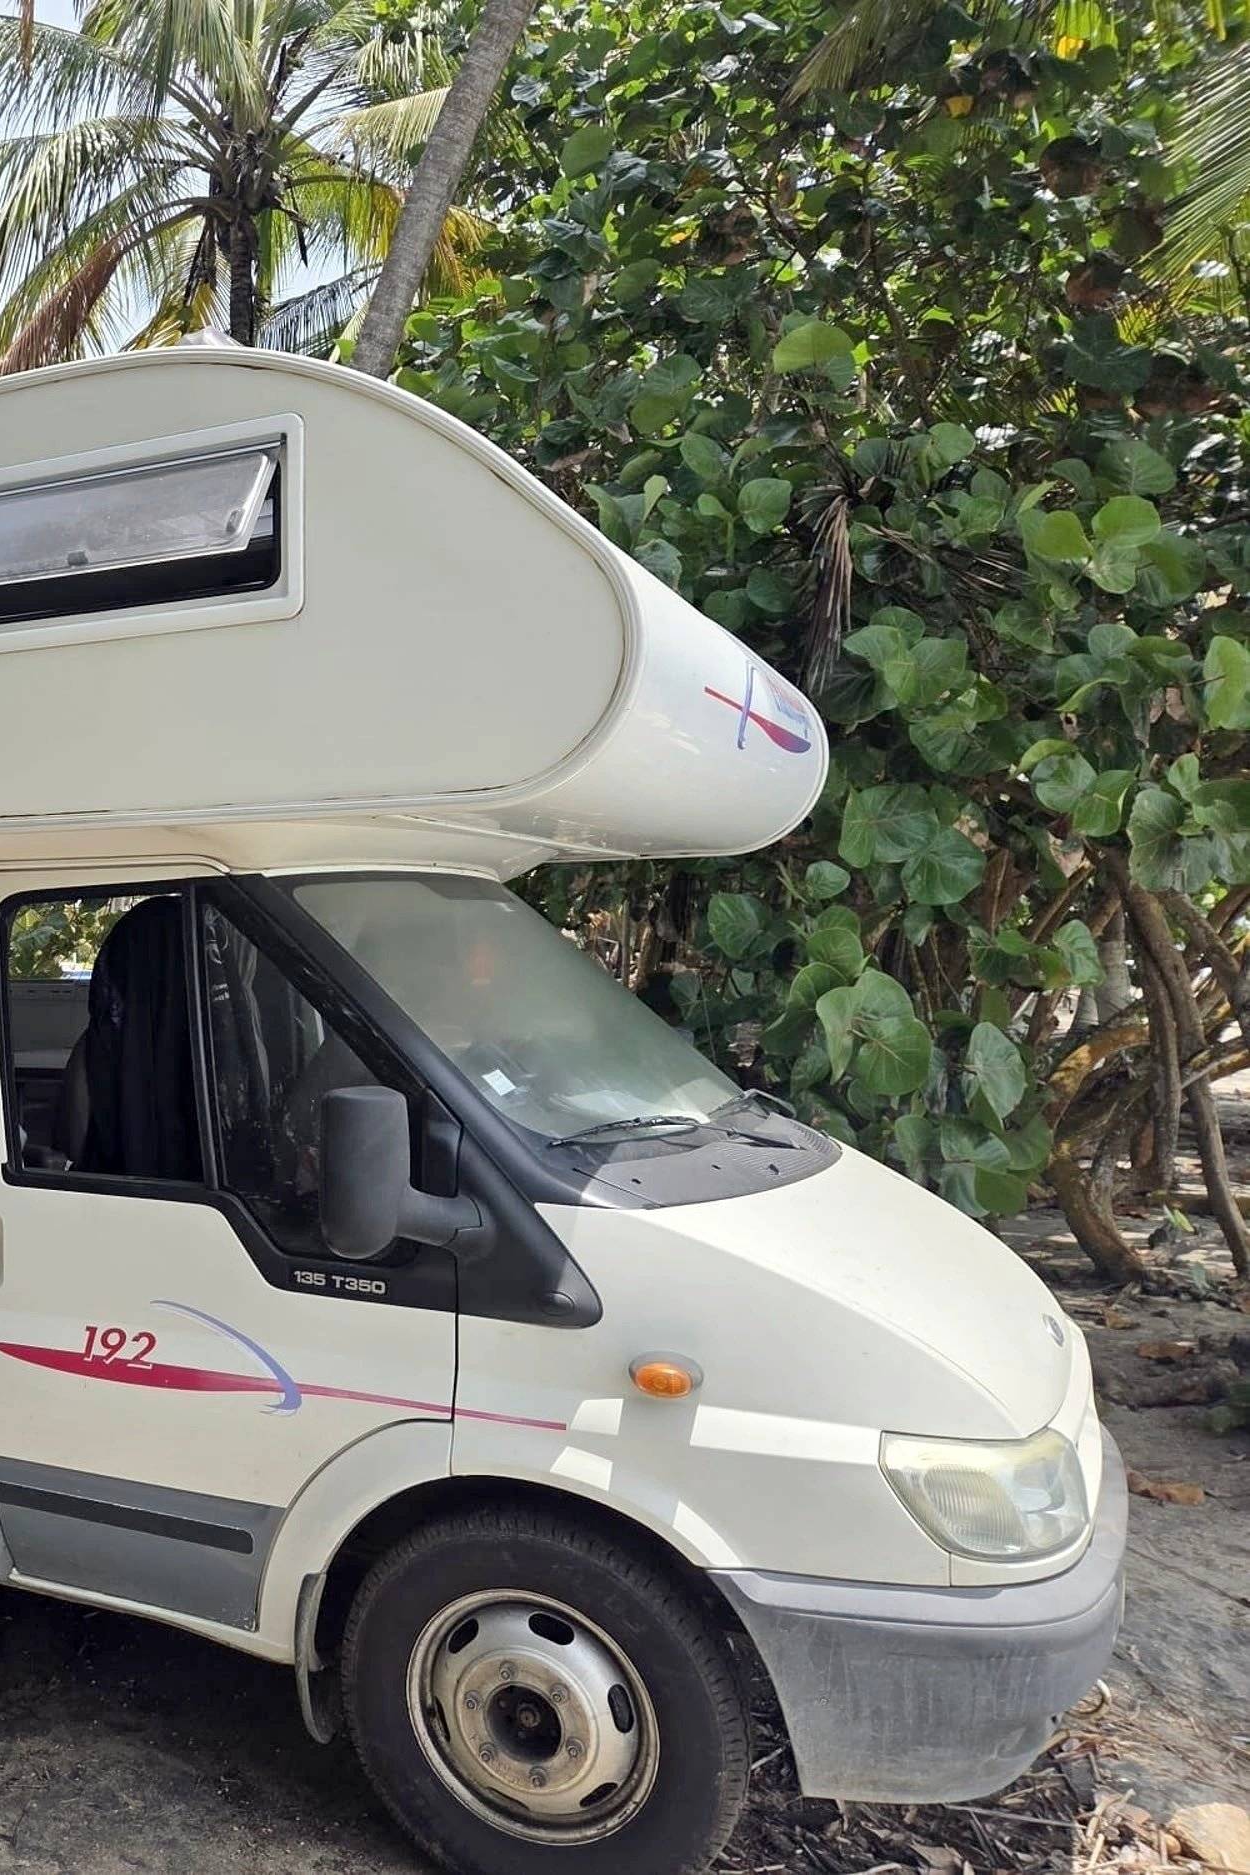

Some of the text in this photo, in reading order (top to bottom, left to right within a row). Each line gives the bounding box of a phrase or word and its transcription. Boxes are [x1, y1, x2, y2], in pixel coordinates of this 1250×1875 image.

[293, 1270, 387, 1295] 135 T350
[82, 1325, 158, 1370] 192
